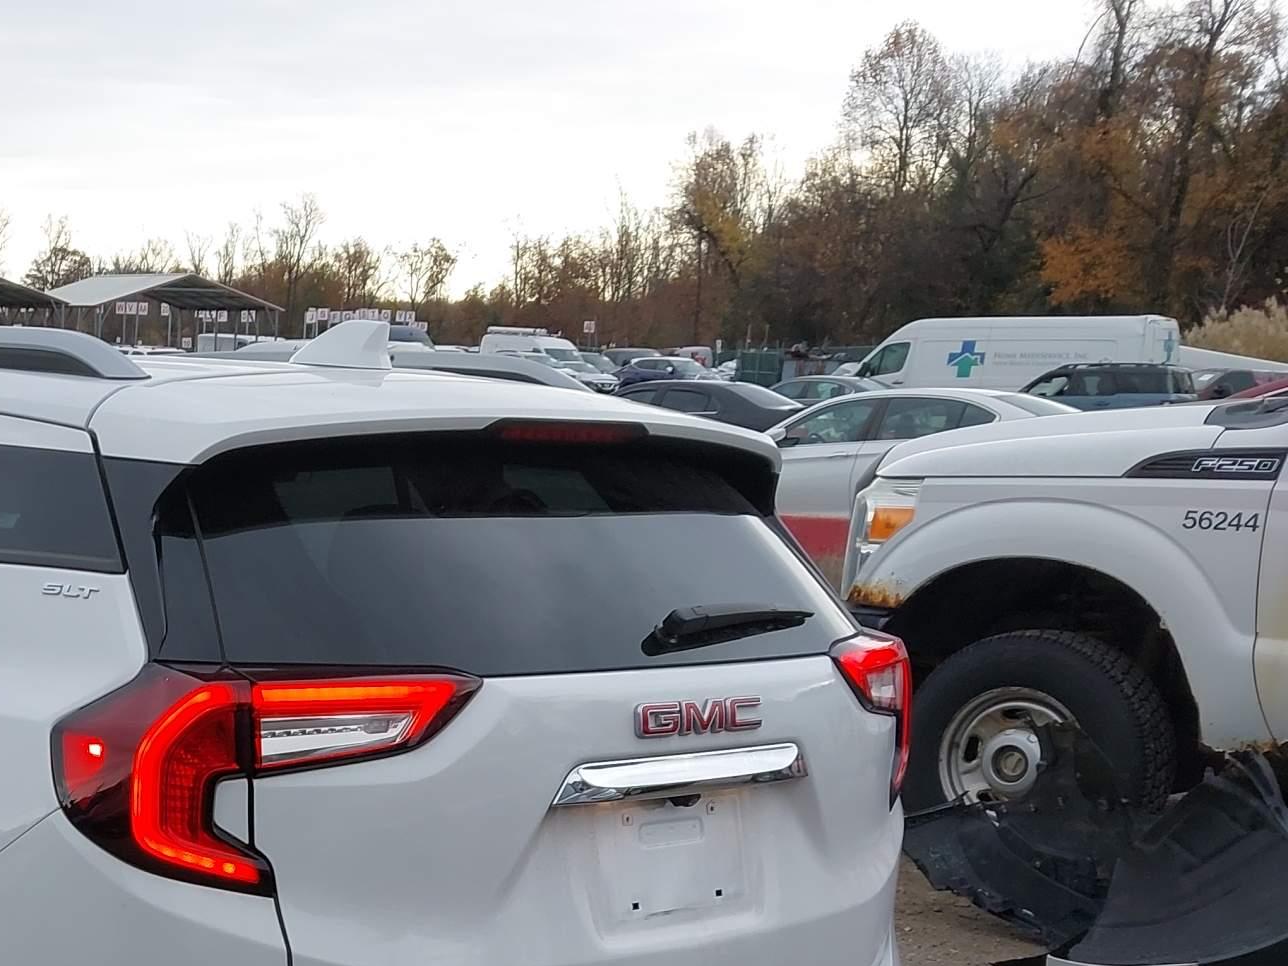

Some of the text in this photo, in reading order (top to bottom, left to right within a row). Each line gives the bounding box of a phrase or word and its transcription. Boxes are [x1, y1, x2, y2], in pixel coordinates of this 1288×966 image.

[1181, 509, 1260, 533] 56244
[41, 582, 100, 600] SLT
[633, 695, 764, 740] GMC
